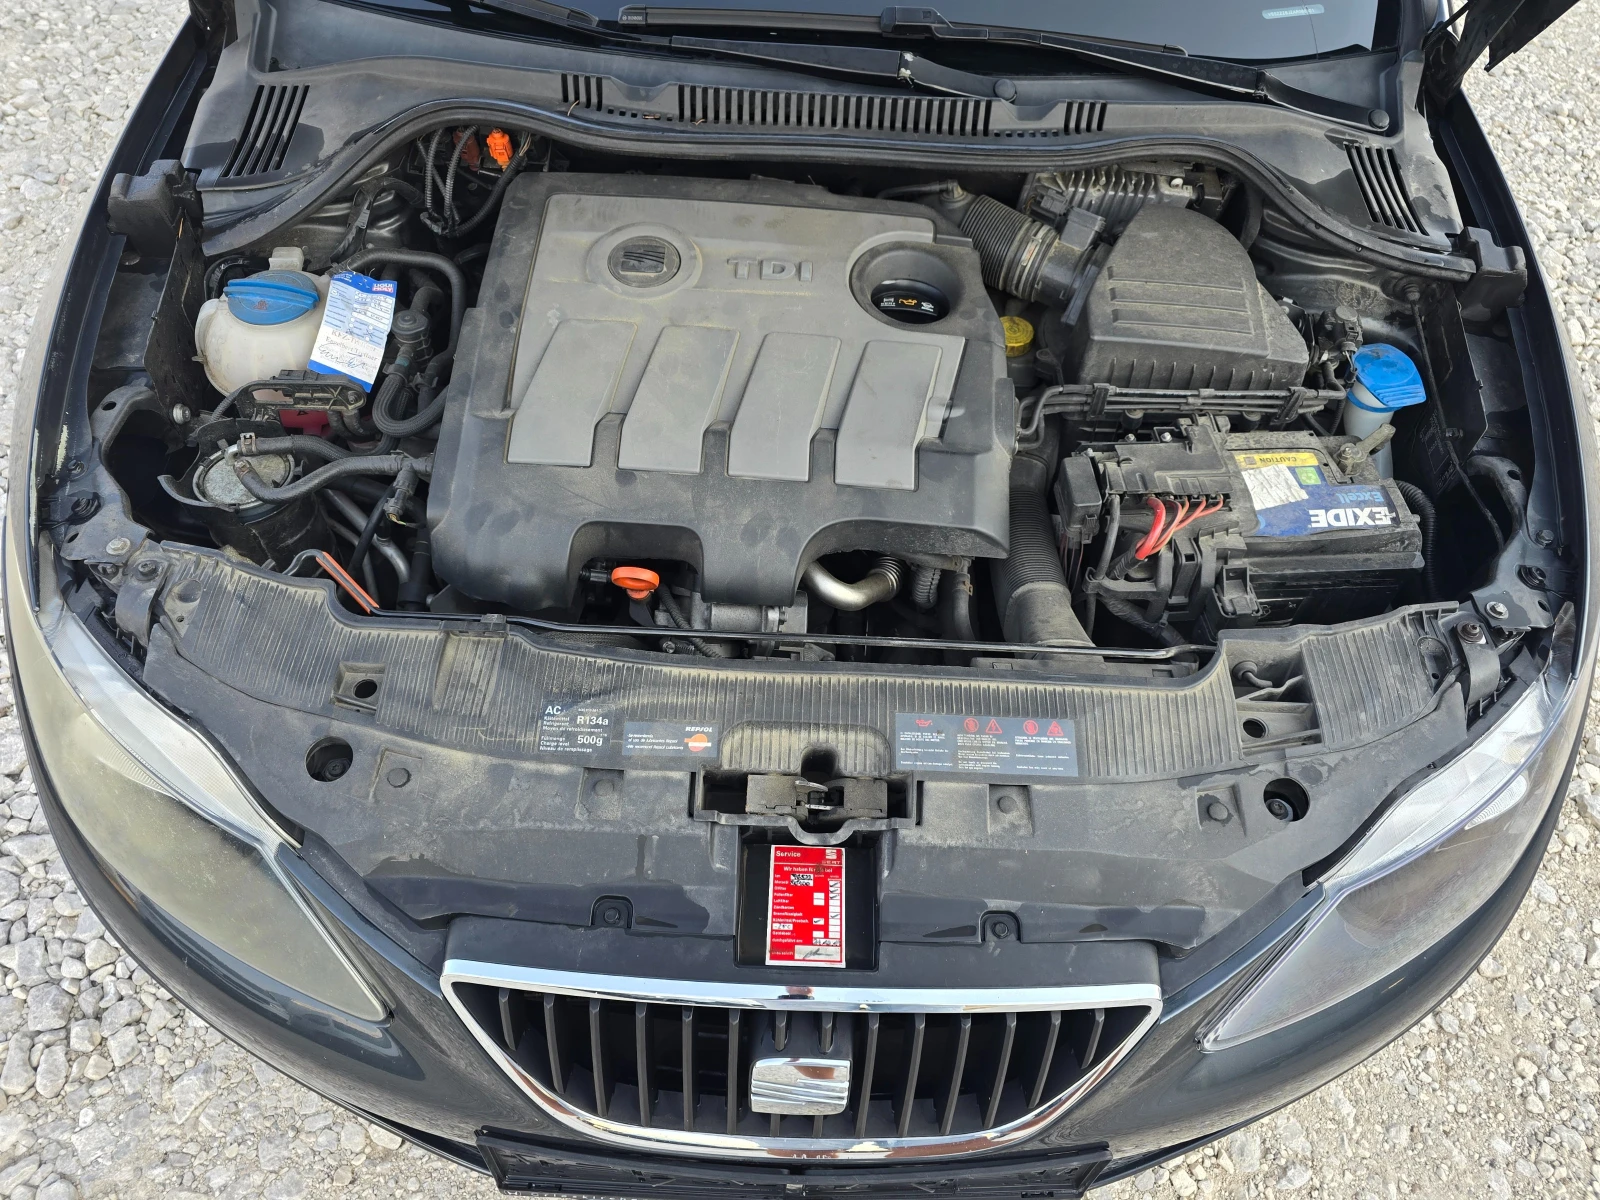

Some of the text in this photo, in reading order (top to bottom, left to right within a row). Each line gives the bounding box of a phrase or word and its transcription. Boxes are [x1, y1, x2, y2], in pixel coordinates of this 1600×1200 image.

[727, 258, 813, 282] TDI
[1338, 491, 1384, 504] Excell
[1311, 507, 1395, 527] EXIDE
[545, 706, 561, 714] AC
[577, 716, 608, 725] R134a
[578, 735, 603, 746] 500g
